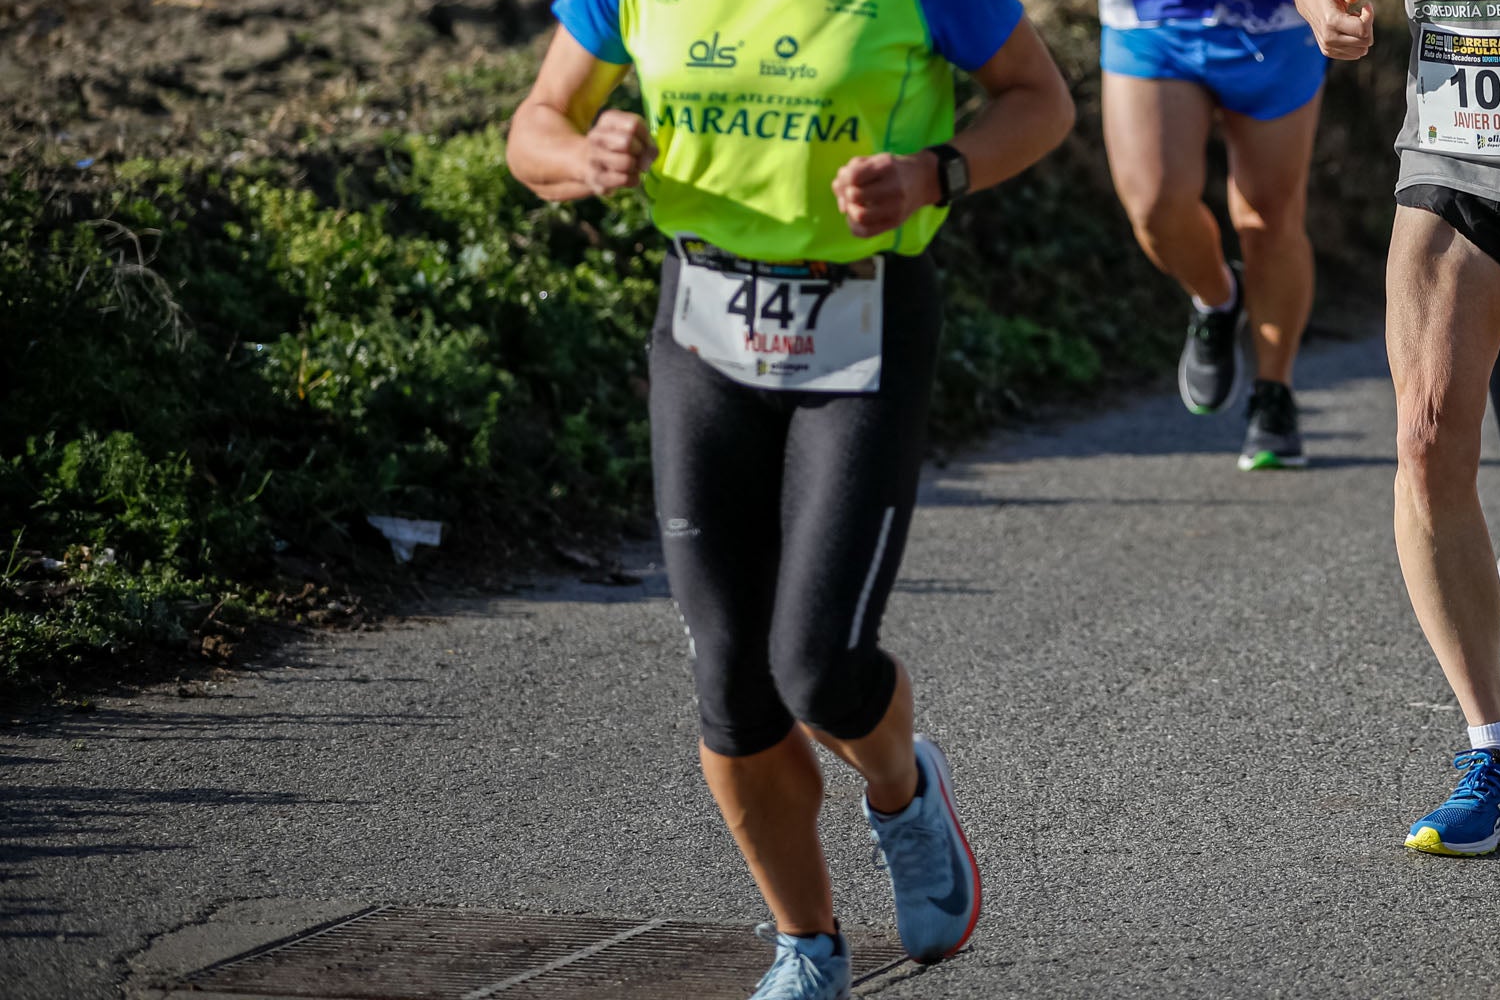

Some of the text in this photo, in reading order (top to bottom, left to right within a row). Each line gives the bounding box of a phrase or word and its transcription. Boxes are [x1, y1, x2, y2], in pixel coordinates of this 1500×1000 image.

[686, 31, 737, 69] als
[1425, 33, 1436, 45] 26
[1424, 50, 1435, 58] Ruta
[1451, 53, 1481, 63] Secaderos
[759, 63, 818, 80] mayfo
[653, 104, 860, 142] MARACENA
[1454, 111, 1490, 130] JAVIER
[726, 278, 833, 331] 447
[743, 331, 816, 356] YOLANDA
